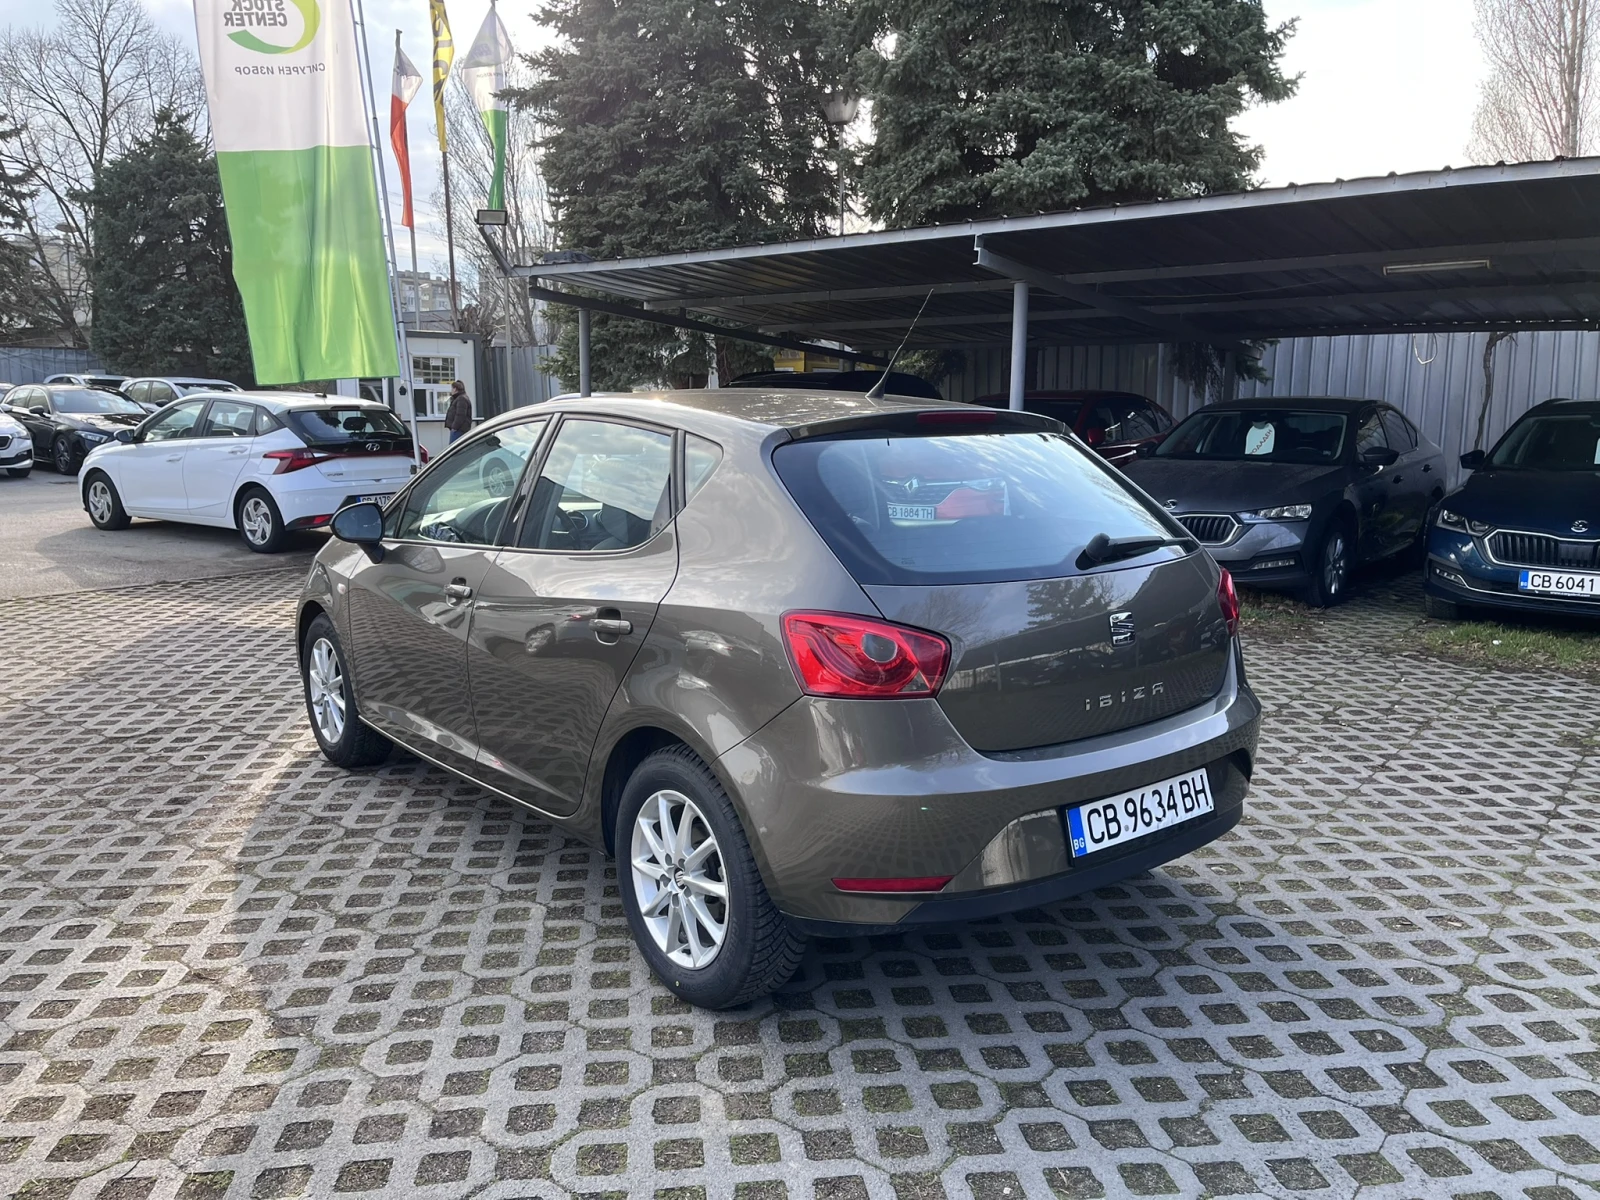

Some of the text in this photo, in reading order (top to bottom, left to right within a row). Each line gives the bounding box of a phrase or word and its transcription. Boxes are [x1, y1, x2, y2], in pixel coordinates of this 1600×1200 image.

[900, 507, 920, 518] 1884
[921, 508, 933, 519] TH
[1531, 574, 1594, 592] CB 6041
[1086, 774, 1210, 844] CB 9634 BH
[1073, 837, 1085, 850] BG
